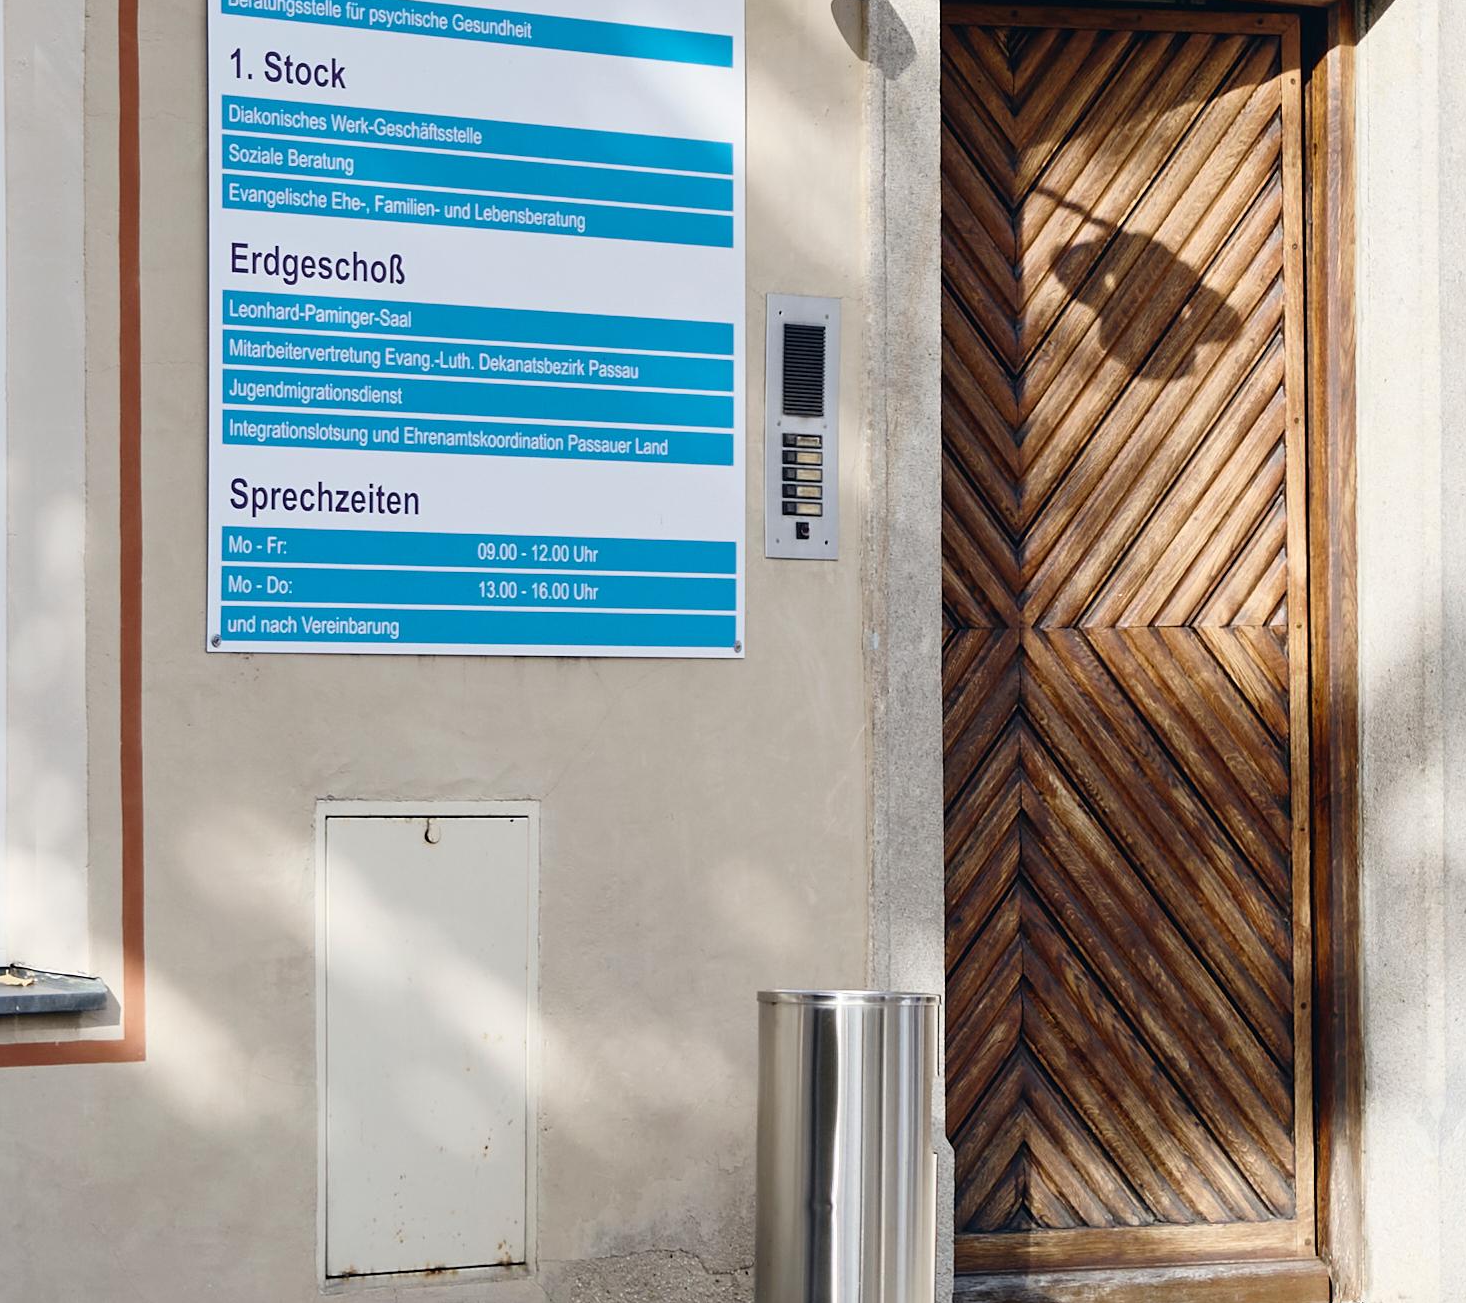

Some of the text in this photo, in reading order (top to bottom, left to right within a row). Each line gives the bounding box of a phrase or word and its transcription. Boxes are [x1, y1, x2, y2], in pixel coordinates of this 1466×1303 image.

[345, 1, 366, 21] für
[369, 7, 448, 31] psychische
[451, 13, 533, 40] Gesundheit
[230, 48, 346, 89] 1. Stock
[228, 104, 482, 145] Diakonisches Werk-Geschäftsstelle
[228, 144, 355, 175] Soziale Beratung
[229, 183, 586, 231] Evangelische Ehe-, Familien- und Lebensberatung
[230, 242, 406, 285] Erdgeschoß
[229, 299, 412, 328] Leonhard-Paminger-Saal
[229, 339, 639, 380] Mitarbeitervertretung Evang.-Luth. Dekanatsbezirk Passau
[229, 378, 403, 405] Jugendmigrationsdienst
[229, 419, 668, 456] Integrationslotsung und Ehrenamtskoordination Passauer Land
[229, 478, 420, 517] Sprechzeiten
[228, 535, 253, 554] Mo
[267, 537, 288, 555] Fr:
[478, 543, 517, 561] 09.00
[531, 544, 570, 562] 12.00
[573, 545, 599, 563] Uhr
[228, 575, 253, 594] Mo
[267, 576, 293, 595] Do:
[479, 581, 517, 599] 13.00
[531, 582, 570, 600] 16.00
[573, 583, 599, 601] Uhr
[227, 616, 400, 638] und nach Vereinbarung
